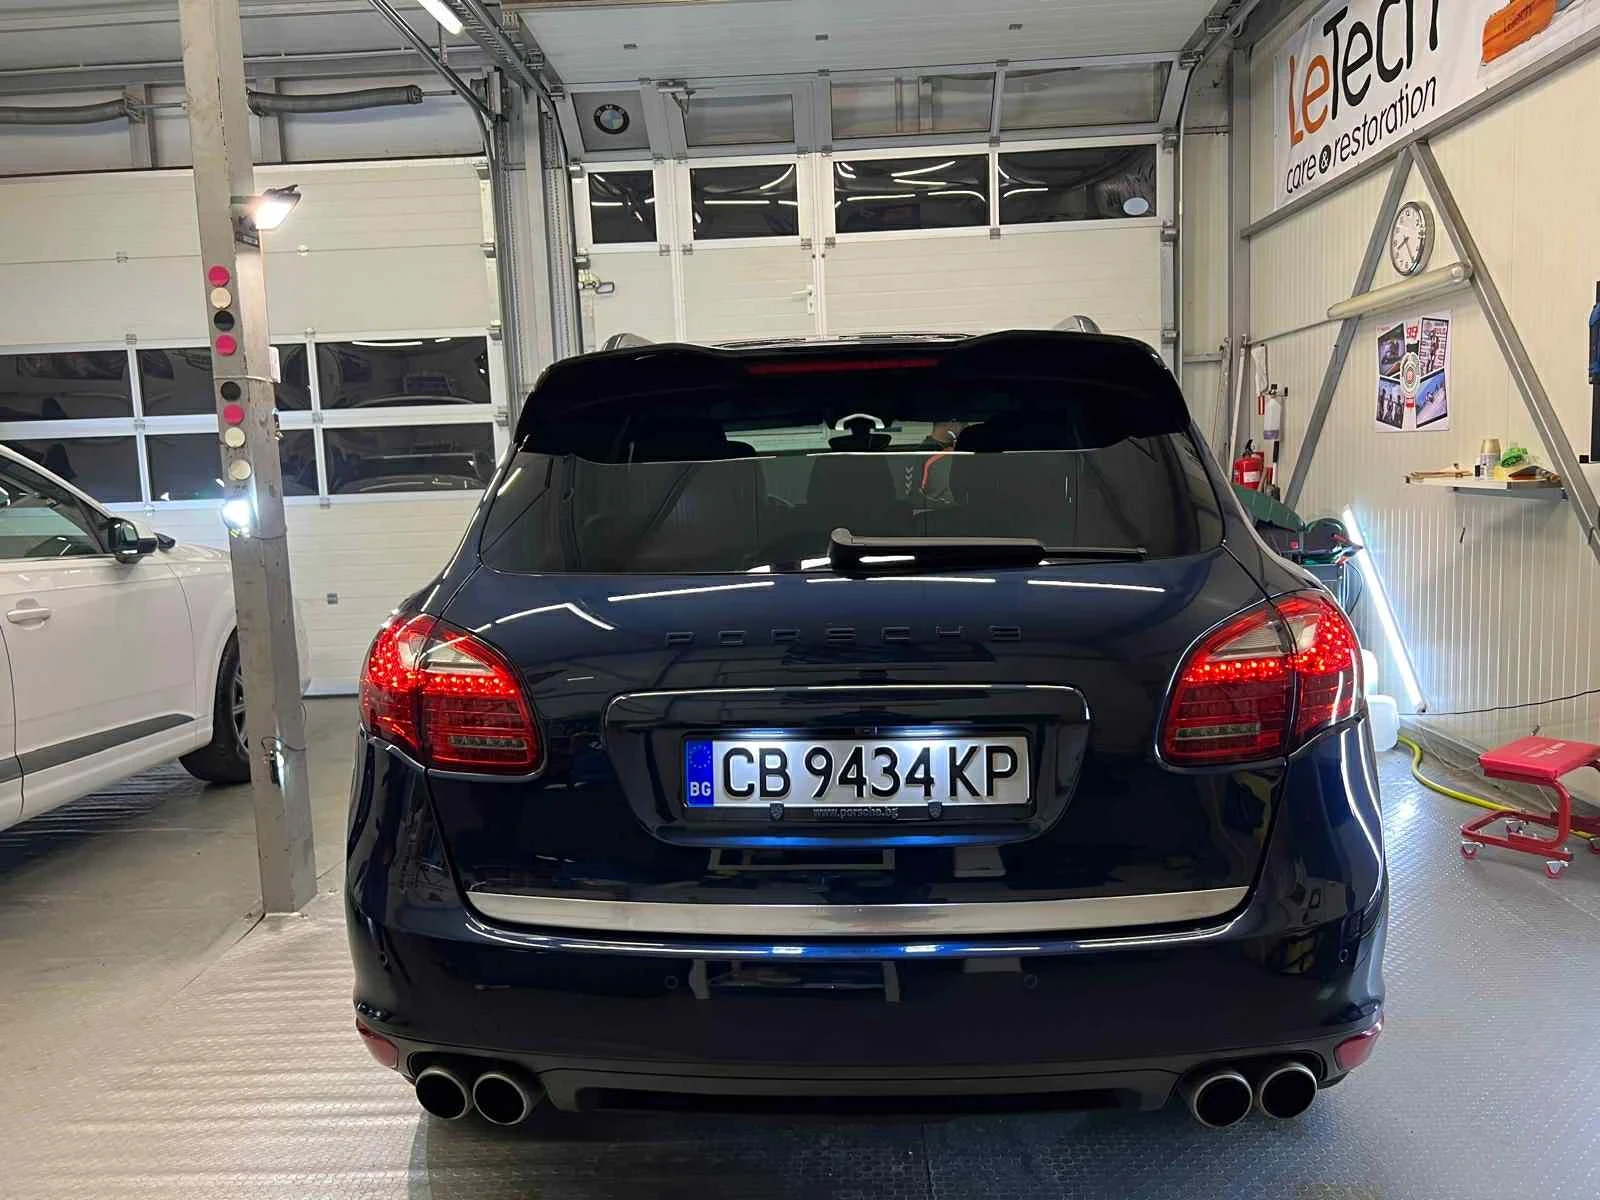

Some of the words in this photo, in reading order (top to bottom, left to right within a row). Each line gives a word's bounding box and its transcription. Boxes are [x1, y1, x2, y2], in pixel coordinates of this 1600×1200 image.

[1286, 154, 1317, 194] care
[1333, 76, 1437, 168] restoration
[690, 781, 711, 797] BG
[722, 746, 791, 798] CB
[804, 745, 935, 798] 9434
[949, 745, 1018, 797] KP
